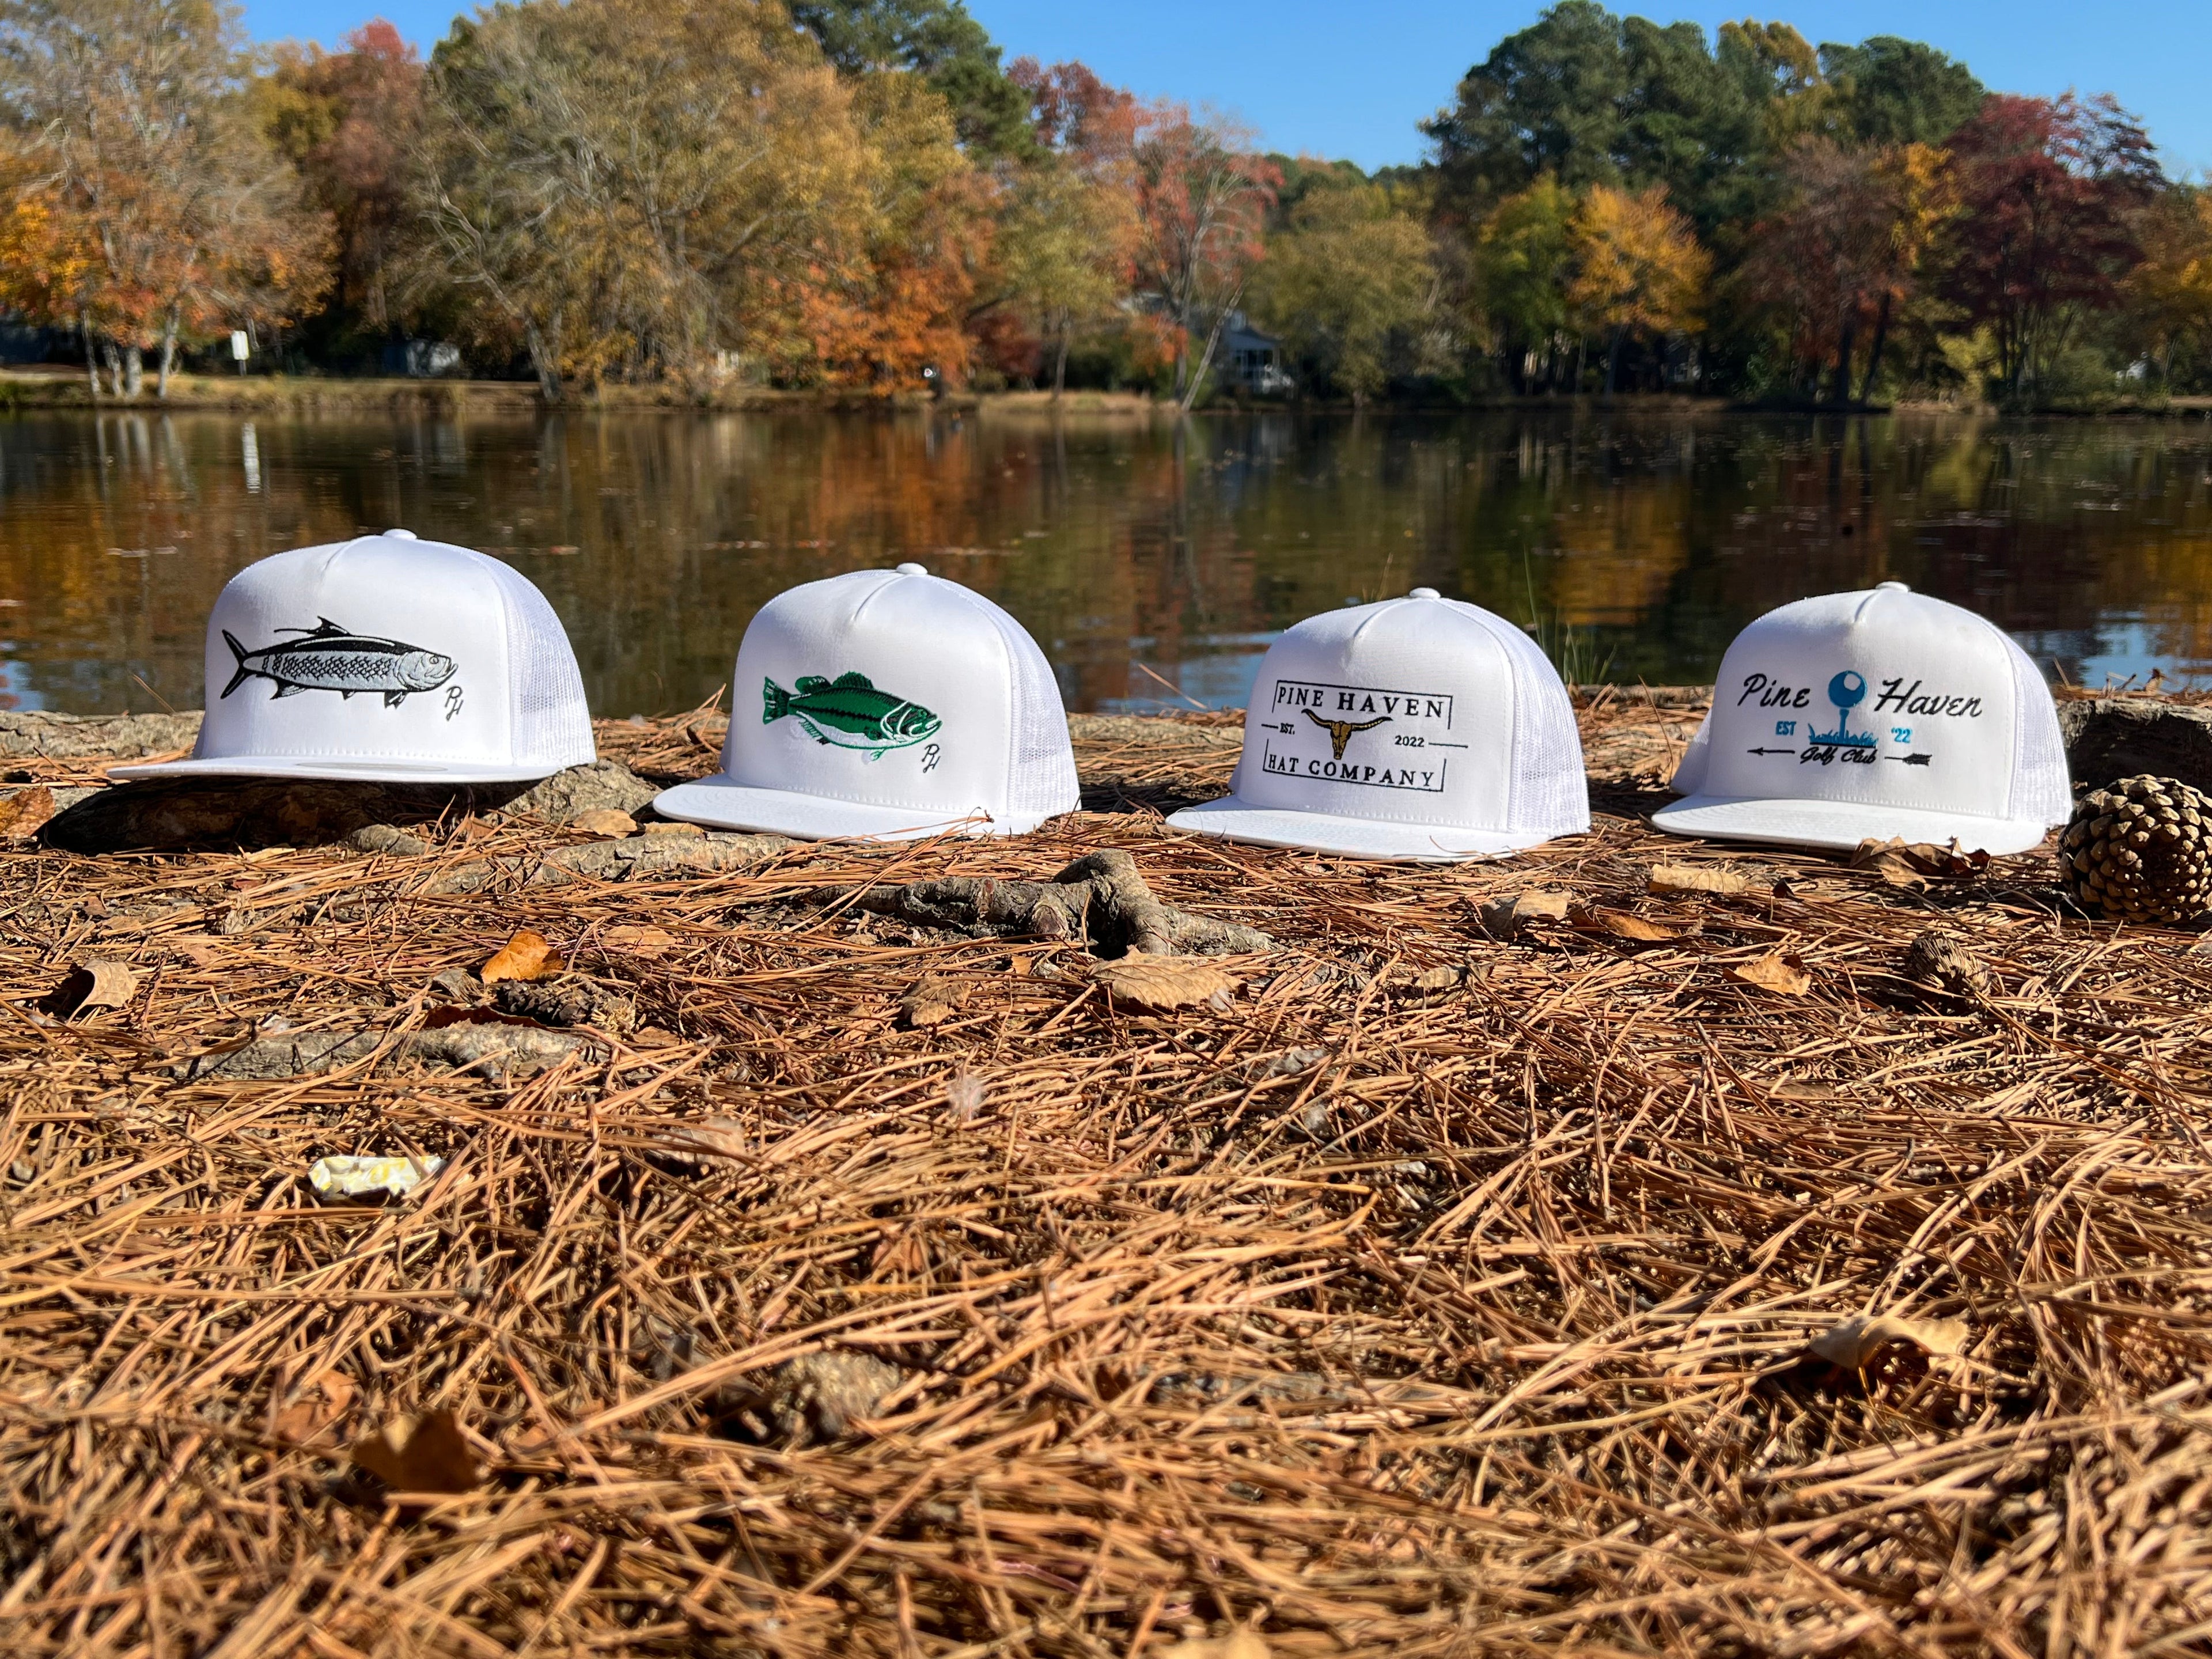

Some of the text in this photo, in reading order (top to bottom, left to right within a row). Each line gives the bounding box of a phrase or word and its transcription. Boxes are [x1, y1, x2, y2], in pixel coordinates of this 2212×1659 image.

[1277, 686, 1444, 718] PINE HAVEN
[1737, 673, 1983, 718] Pine Haven
[1279, 723, 1425, 747] EST. 2022
[1775, 721, 1797, 736] EST
[1800, 746, 1877, 766] Golf Club
[1268, 754, 1435, 787] HAT COMPANY
